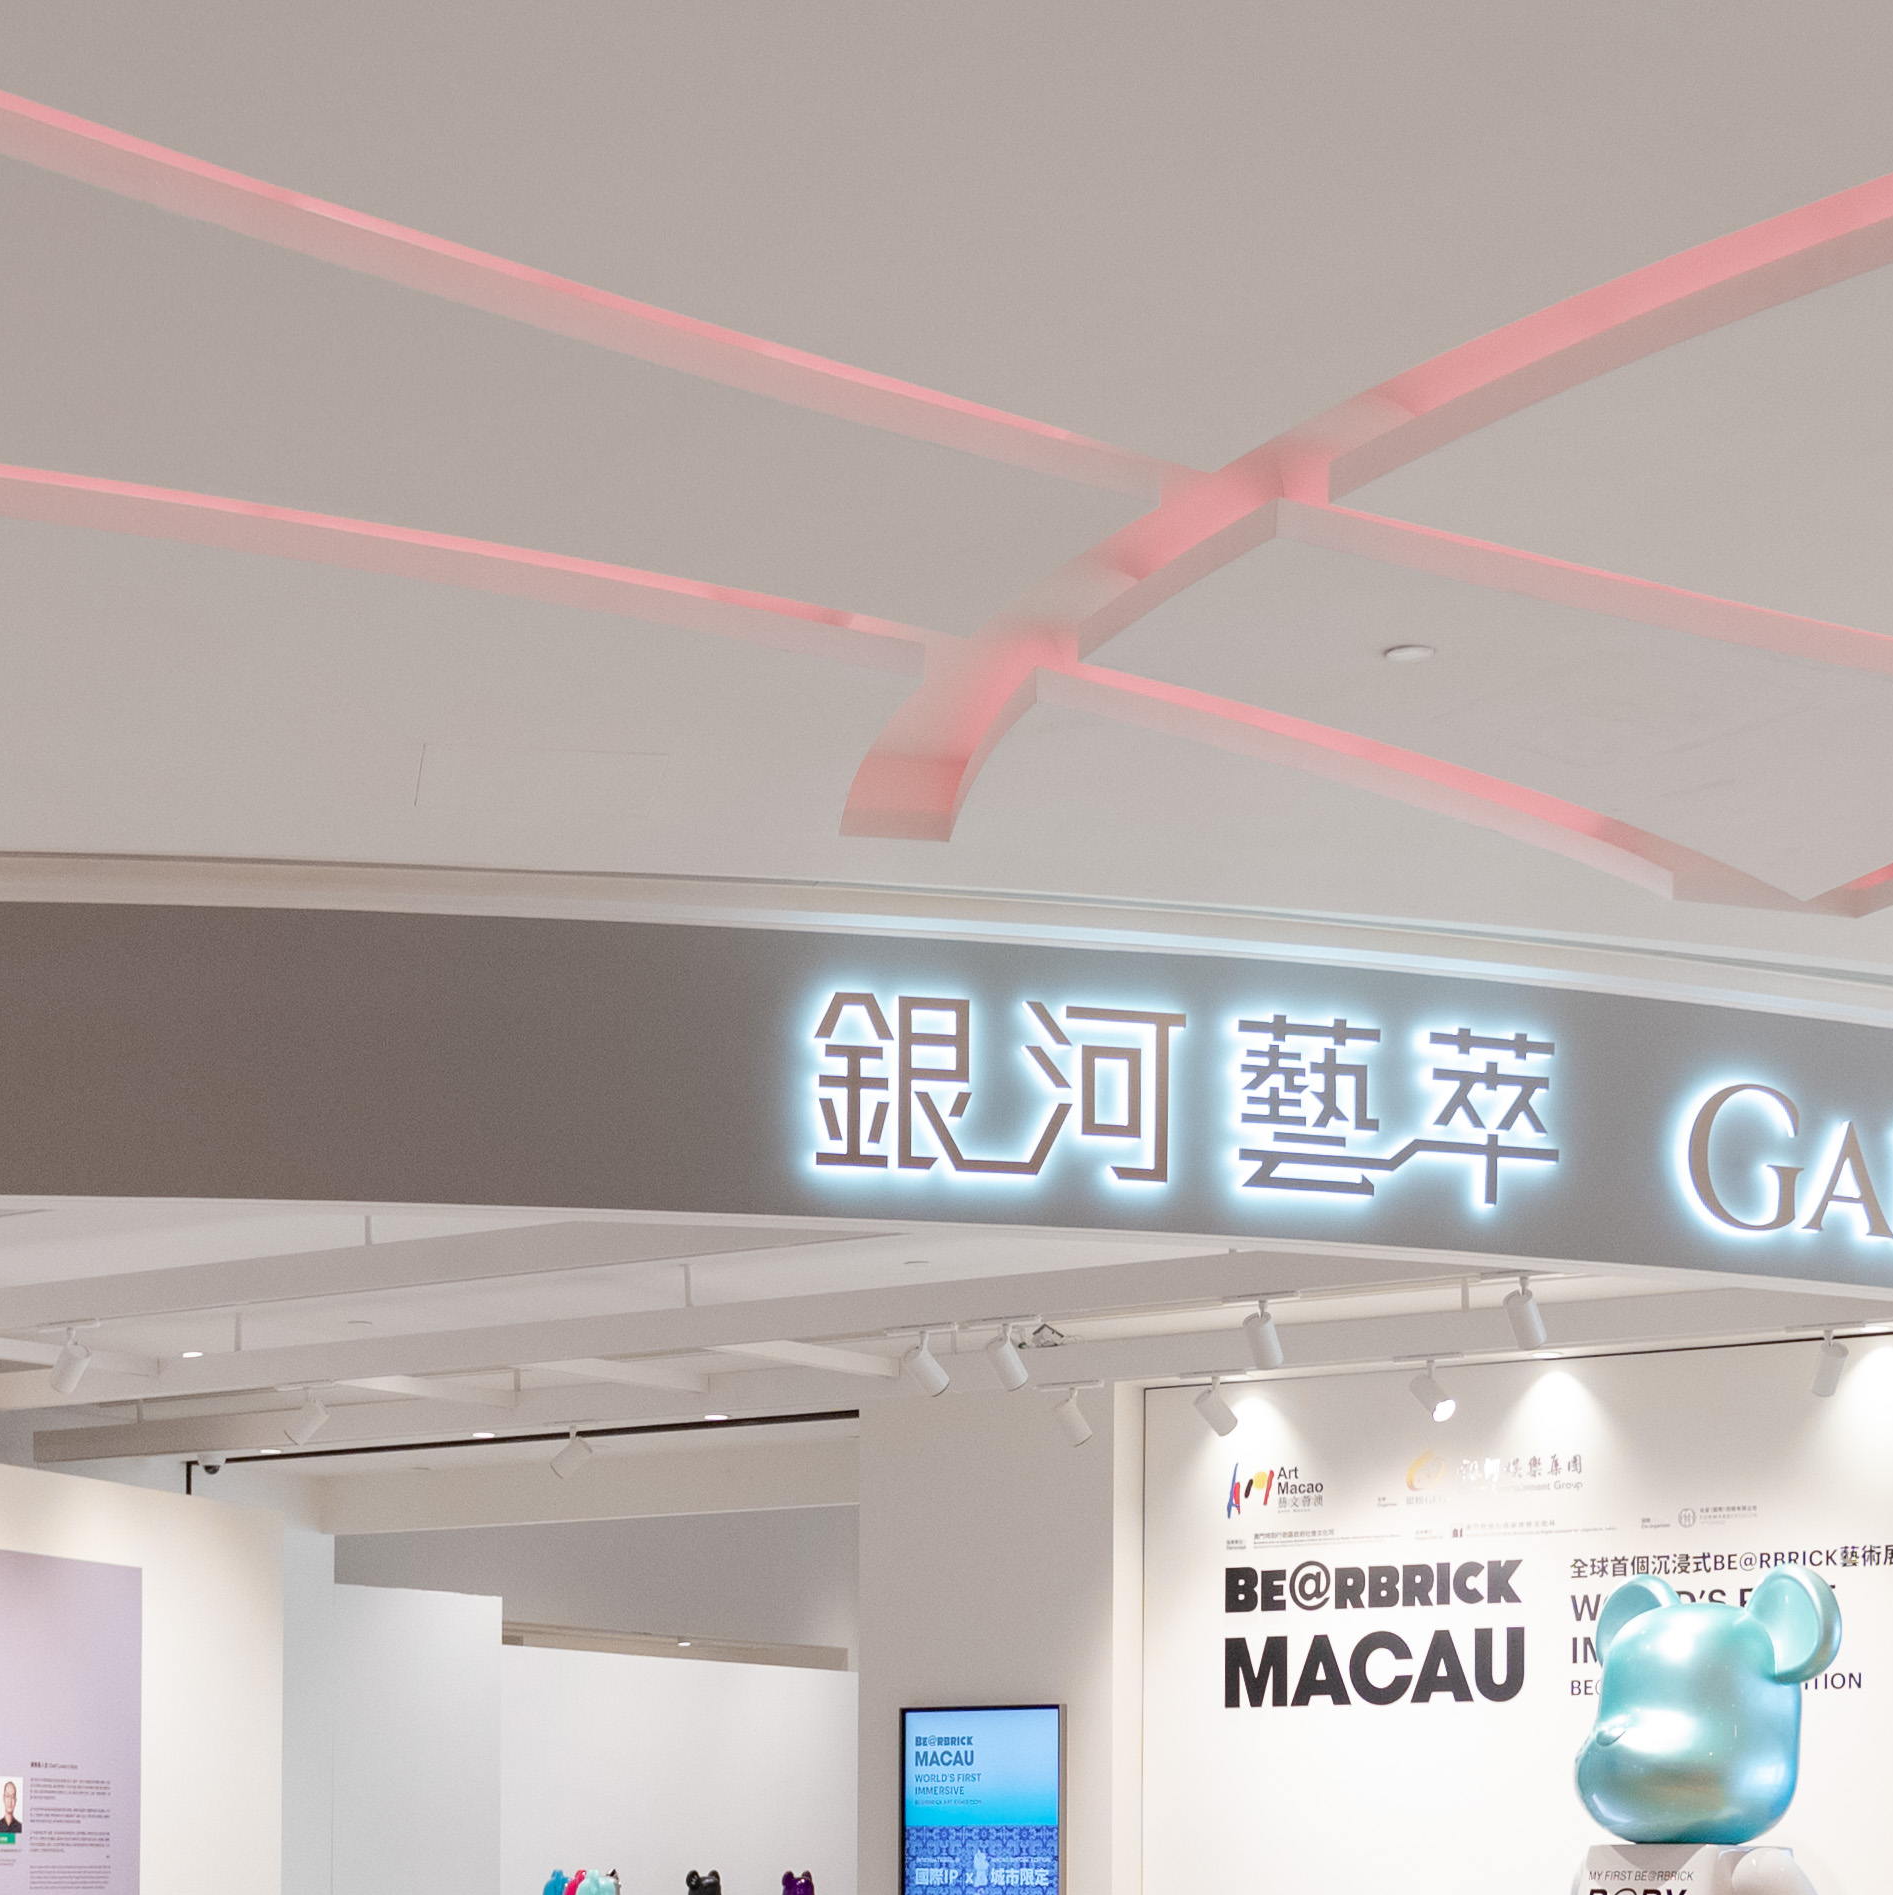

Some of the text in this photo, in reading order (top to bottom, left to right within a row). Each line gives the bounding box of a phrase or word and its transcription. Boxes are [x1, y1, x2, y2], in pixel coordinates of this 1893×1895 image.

[815, 991, 1558, 1204] 銀河藝萃
[1278, 1467, 1299, 1480] Art
[1278, 1482, 1324, 1495] Macao
[1225, 1559, 1522, 1613] BE@RBRICK
[1225, 1626, 1525, 1709] MACAU
[915, 1736, 973, 1747] BE@RBRICK
[915, 1750, 974, 1767] MACAU
[915, 1773, 981, 1783] WORLD'S FIRST
[915, 1786, 964, 1795] IMMERSIVE
[991, 1868, 1049, 1886] 城市限定
[1589, 1871, 1694, 1881] MY FIRST BE@RBRICK
